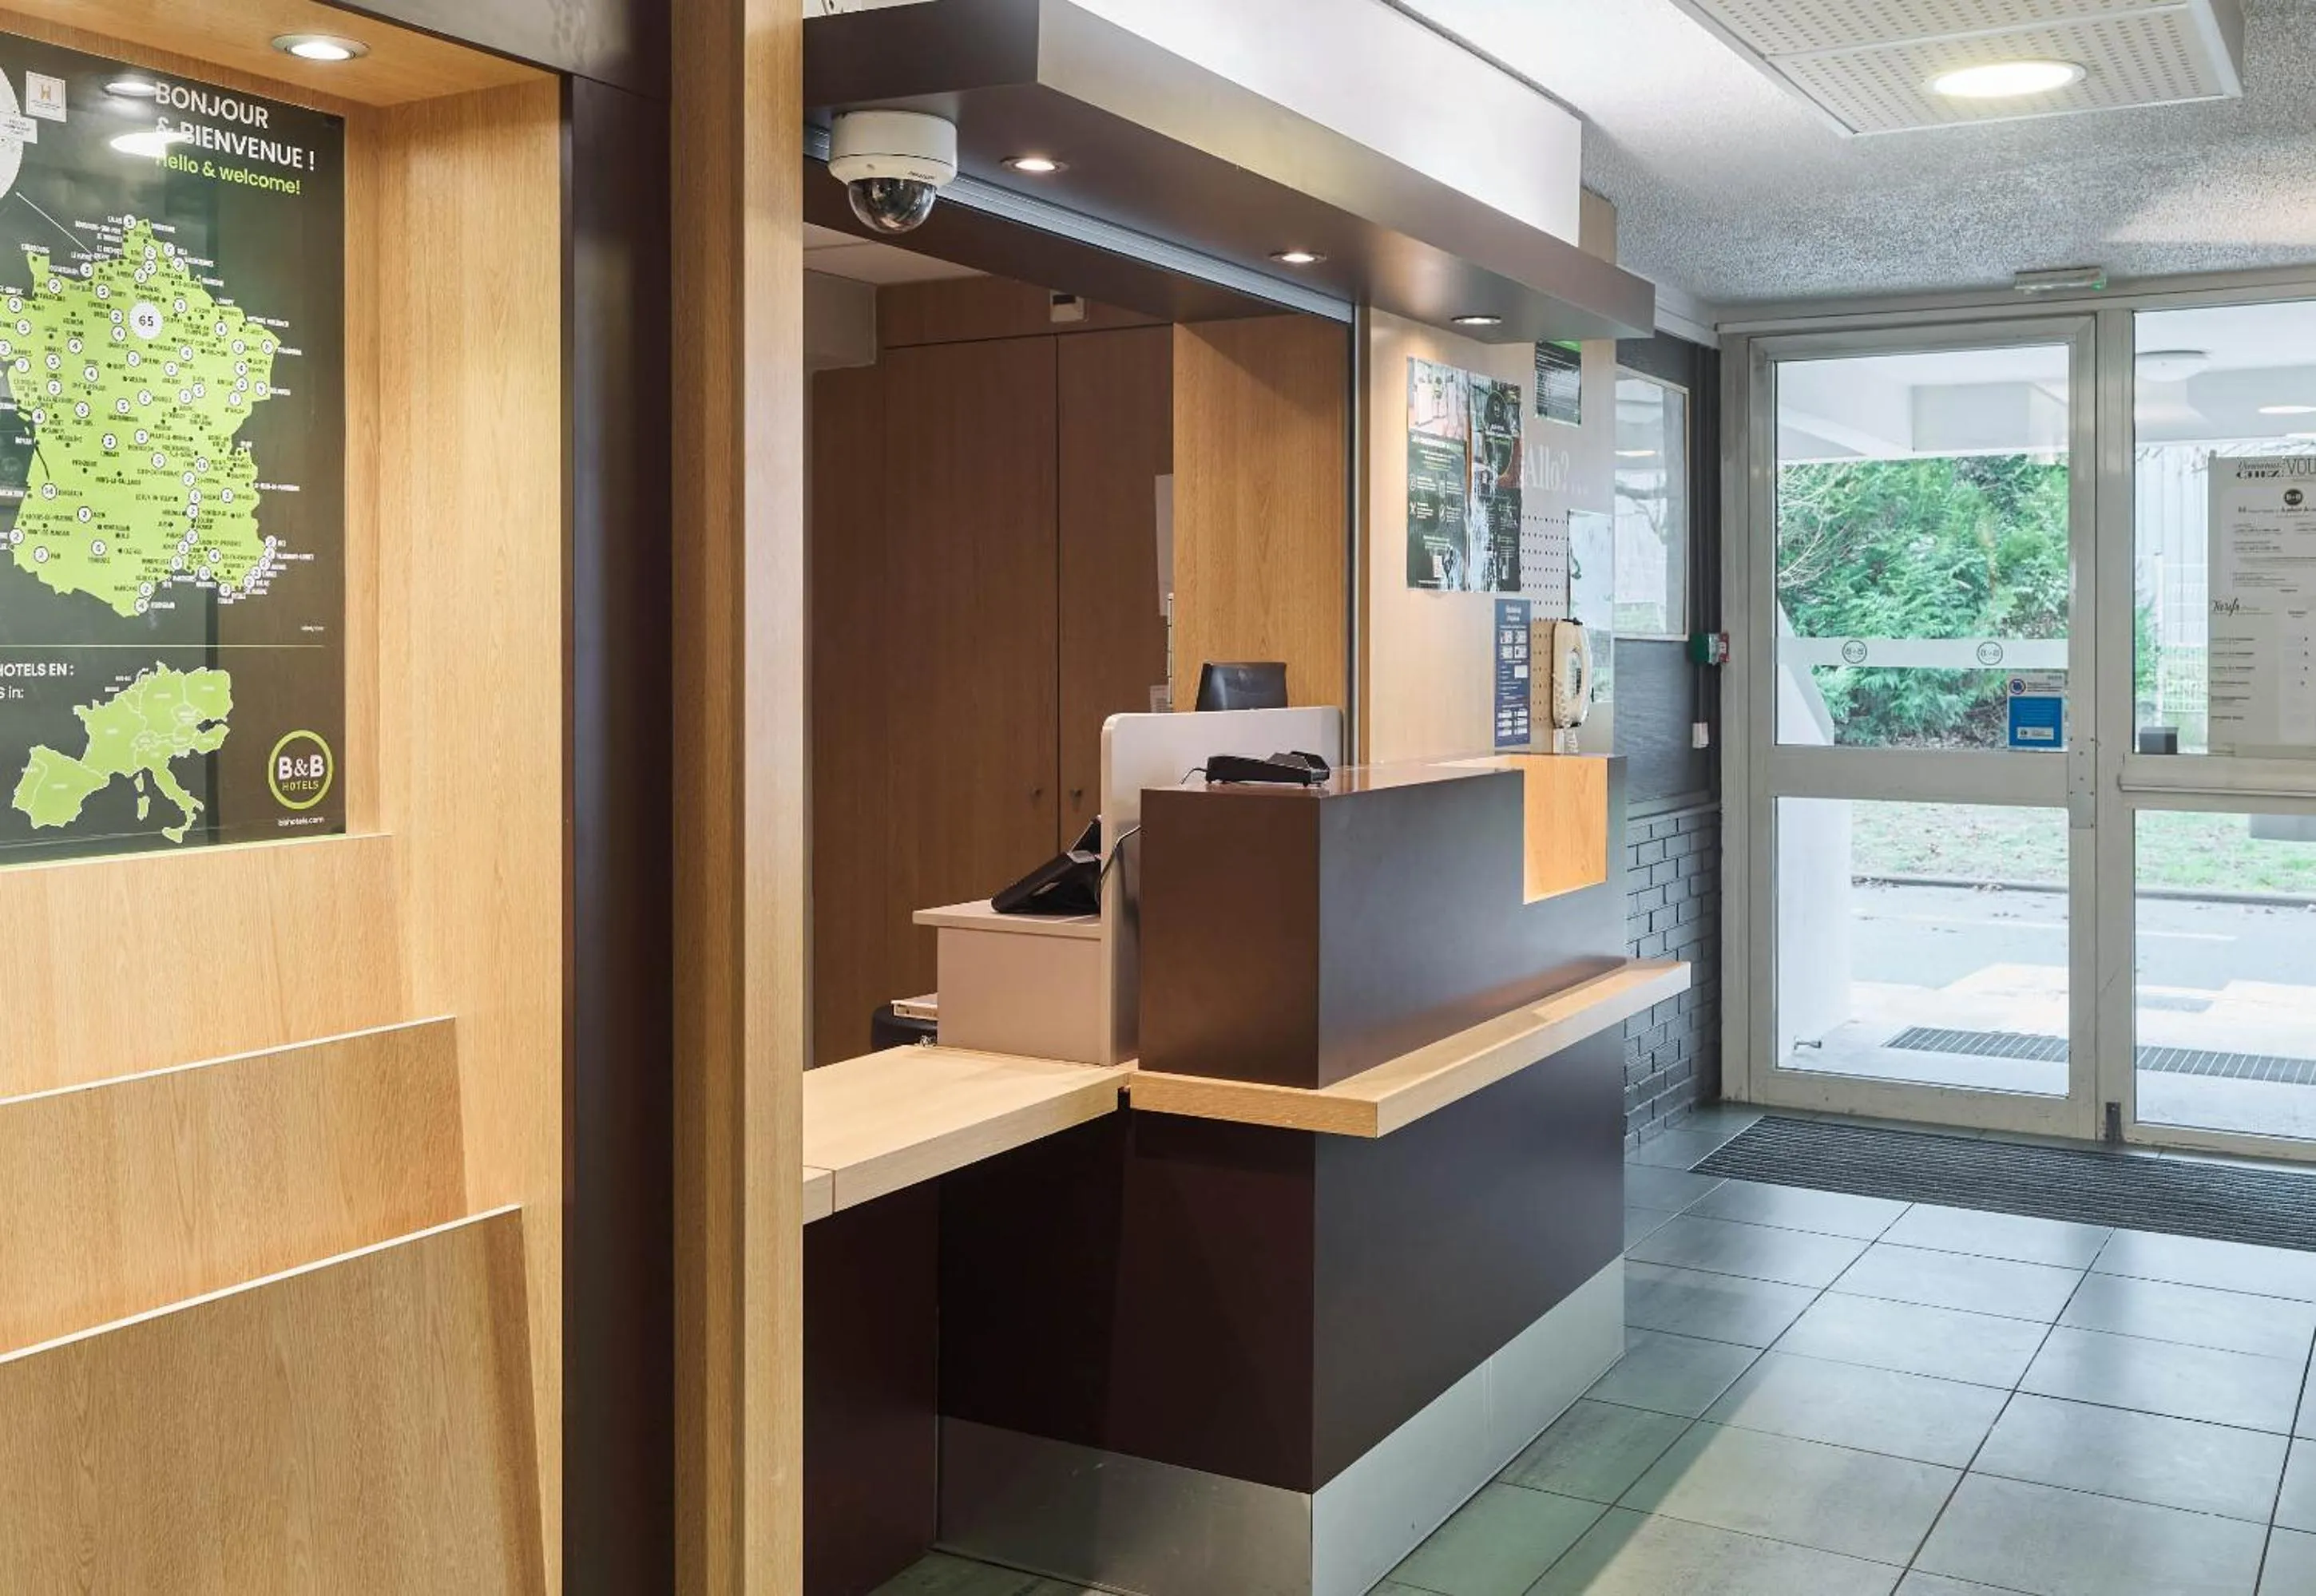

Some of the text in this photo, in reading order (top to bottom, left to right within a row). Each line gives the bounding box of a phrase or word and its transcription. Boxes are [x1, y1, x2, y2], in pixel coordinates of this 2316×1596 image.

[155, 81, 269, 129] BONJOUR
[180, 121, 303, 169] BIENVENUE
[202, 160, 216, 179] &
[220, 167, 301, 195] welcome!
[139, 315, 154, 327] 65
[279, 754, 325, 780] B&B
[282, 780, 319, 791] HOTELS
